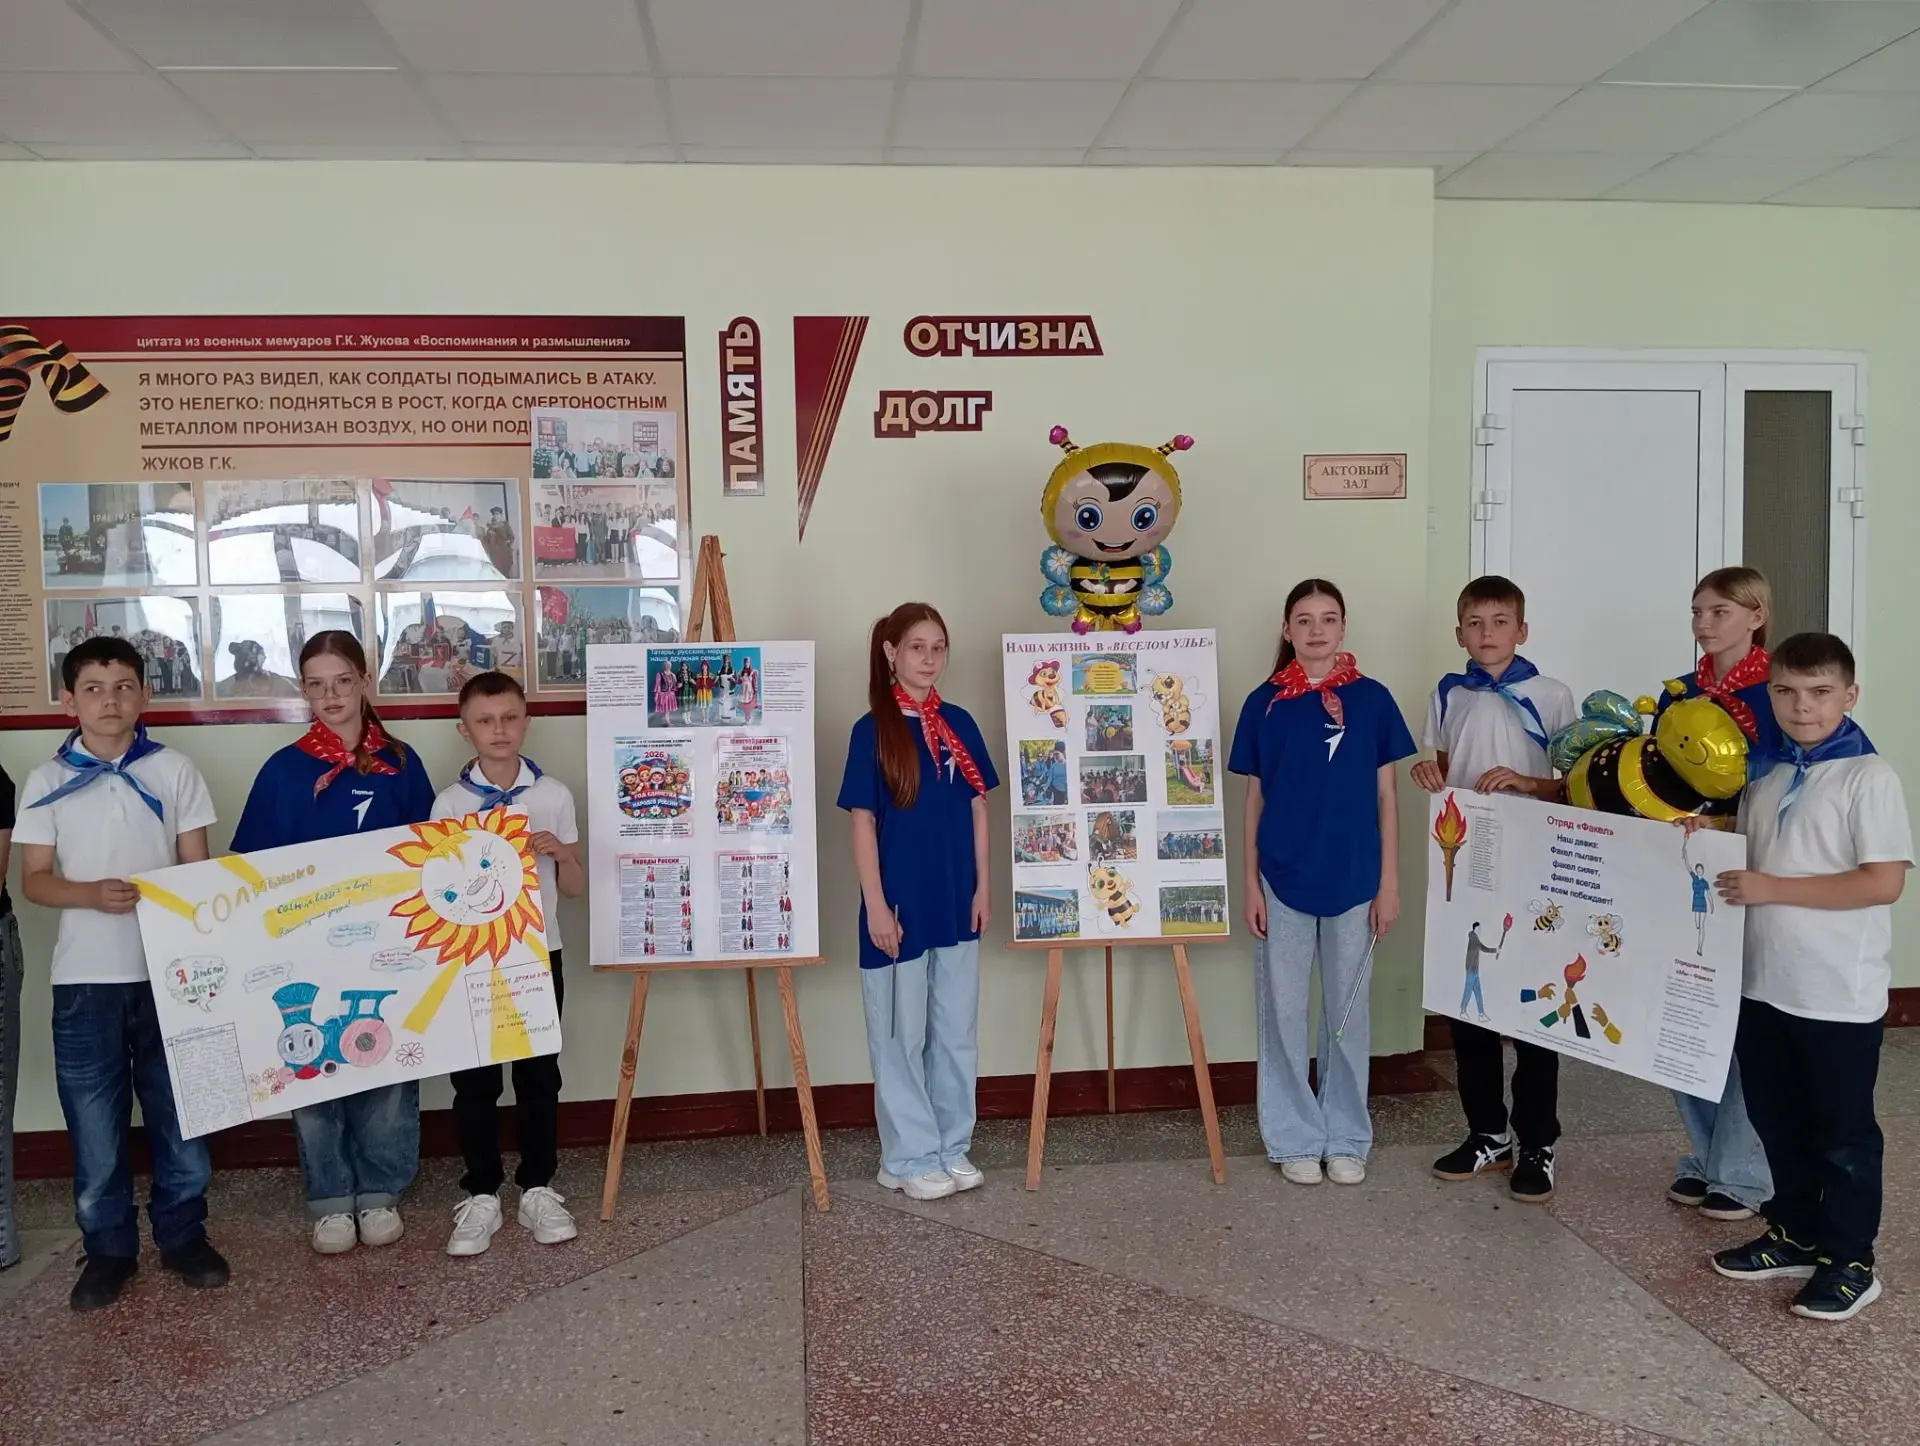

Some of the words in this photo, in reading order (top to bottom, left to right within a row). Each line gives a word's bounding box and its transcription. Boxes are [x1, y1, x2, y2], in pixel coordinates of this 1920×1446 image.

[136, 336, 181, 348] цитата
[185, 337, 200, 347] из
[204, 336, 262, 347] военных
[266, 337, 332, 349] мемуаров
[335, 334, 357, 347] Г.К.
[360, 335, 410, 349] Жукова
[414, 335, 517, 347] «Воспоминания
[521, 336, 529, 346] и
[532, 336, 631, 349] размышления»
[910, 321, 1094, 351] ОТЧИЗНА
[139, 372, 150, 386] Я
[156, 372, 218, 386] МНОГО
[222, 372, 254, 386] РАЗ
[260, 372, 324, 388] ВИДЕЛ,
[329, 372, 362, 385] КАК
[366, 372, 451, 387] СОЛДАТЫ
[457, 372, 582, 386] ПОДЫМАЛИСЬ
[586, 372, 598, 385] В
[603, 372, 657, 386] АТАКУ.
[140, 397, 174, 411] ЭТО
[180, 397, 264, 411] НЕЛЕГКО:
[270, 396, 376, 412] ПОДНЯТЬСЯ
[382, 396, 393, 410] В
[398, 396, 447, 412] РОСТ,
[452, 396, 507, 412] КОГДА
[512, 396, 668, 410] СМЕРТОНОСТНЫМ
[726, 323, 758, 490] ПАМЯТЬ
[880, 397, 986, 431] ДОЛГ
[140, 422, 238, 435] МЕТАЛЛОМ
[243, 421, 338, 434] ПРОНИЗАН
[343, 420, 416, 436] ВОЗДУХ,
[422, 420, 446, 434] НО
[452, 420, 487, 434] ОНИ
[142, 456, 204, 470] ЖУКОВ
[210, 456, 236, 470] Г.К.
[1322, 463, 1389, 476] АКТОВЫЙ
[1344, 479, 1368, 489] ЗАЛ
[1546, 816, 1575, 830] Отряд
[1576, 822, 1614, 836] «Факел»
[1557, 834, 1574, 844] Наш
[1550, 846, 1574, 858] Факел
[1574, 852, 1604, 864] пылает,
[1577, 866, 1600, 876] сияет,
[1576, 879, 1600, 890] всегда
[1540, 884, 1550, 892] во
[1550, 886, 1568, 896] всем
[1570, 890, 1614, 906] побеждает!
[176, 968, 188, 985] Я
